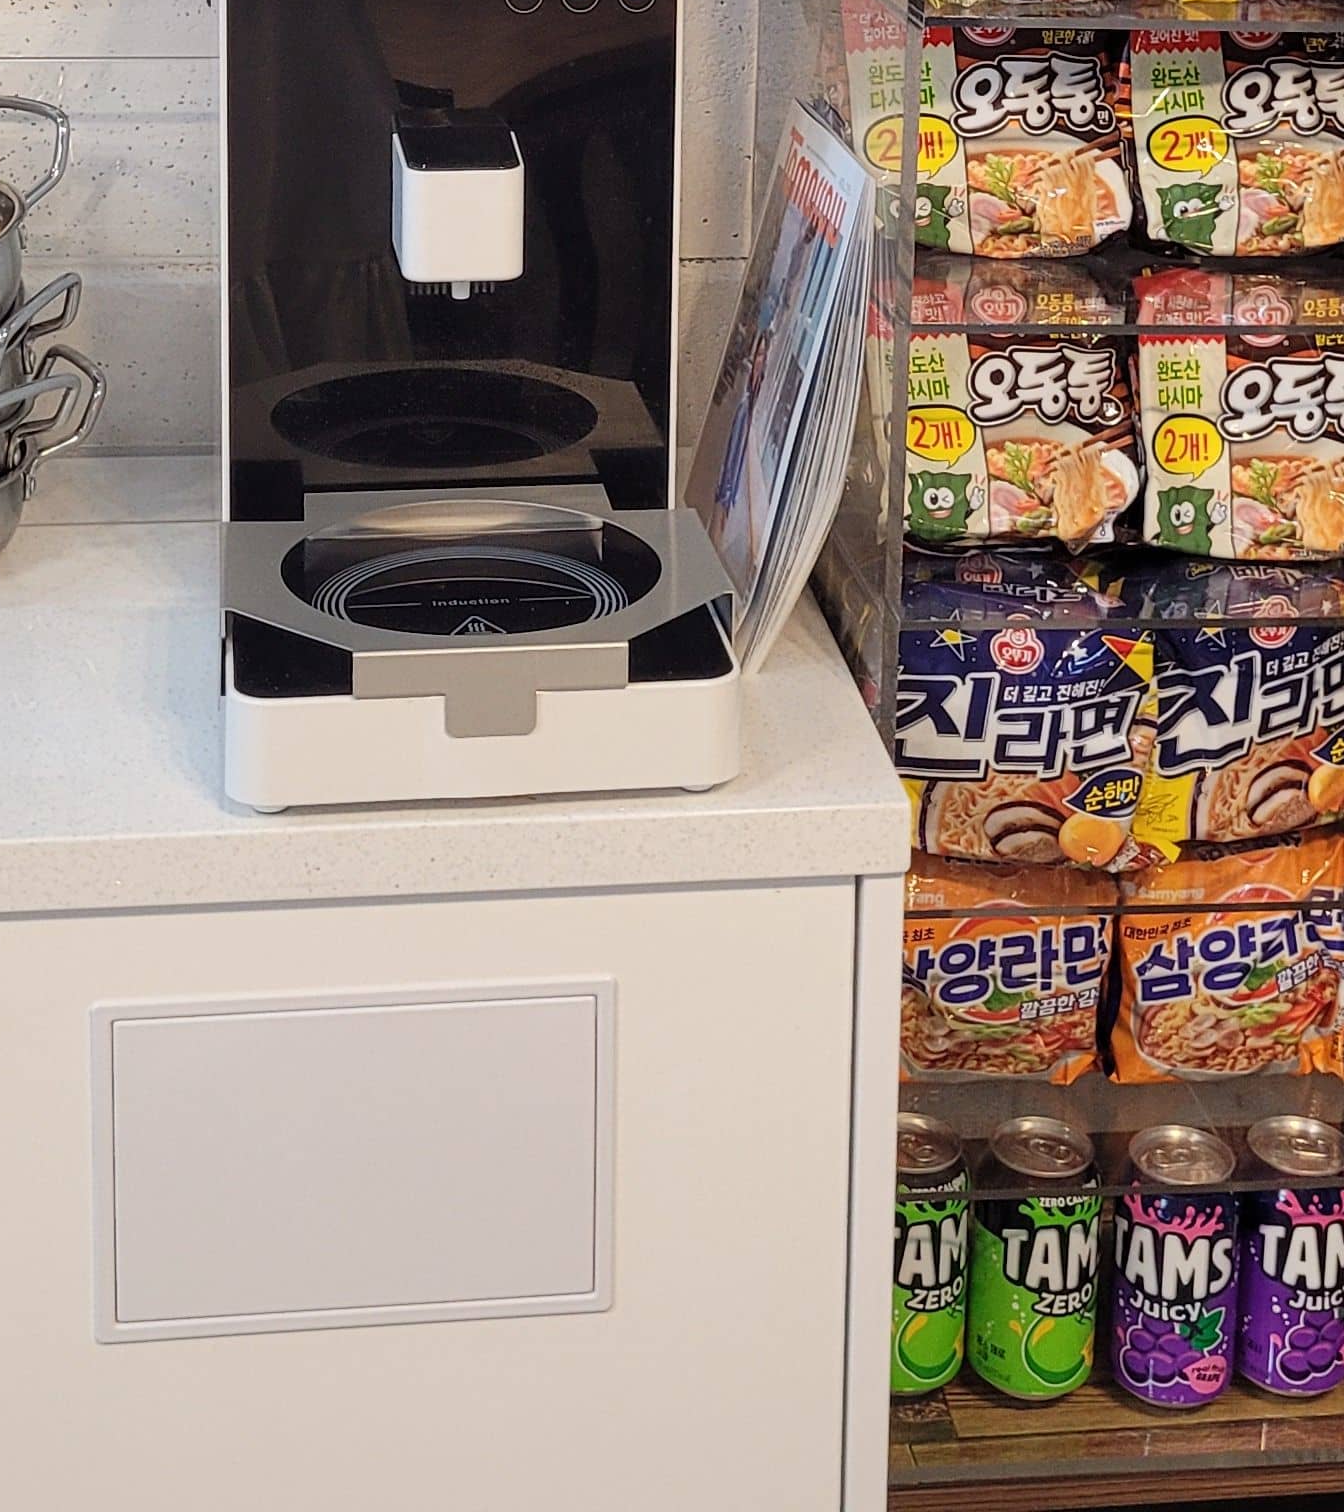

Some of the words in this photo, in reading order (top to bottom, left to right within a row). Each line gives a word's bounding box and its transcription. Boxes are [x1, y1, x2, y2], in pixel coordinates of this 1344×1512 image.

[1150, 66, 1200, 87] 완도산
[1156, 359, 1201, 383] 완도산
[1157, 384, 1203, 412] 다시마
[910, 415, 964, 451] 2개!
[1163, 431, 1209, 463] 2개!
[1001, 647, 1033, 664] 오뚜기
[1265, 659, 1279, 677] 더
[1282, 652, 1309, 672] 깊고
[1003, 686, 1018, 704] 더
[1023, 683, 1053, 703] 깊고
[1056, 678, 1106, 702] 진해진!
[896, 672, 1142, 781] 진라면
[1083, 777, 1140, 809] 순한맛
[1019, 994, 1075, 1021] 깔끔한
[1114, 1215, 1235, 1300] TAMS
[906, 1279, 964, 1313] ZERO
[1034, 1286, 1094, 1317] ZERO
[1128, 1293, 1203, 1324] Juicy
